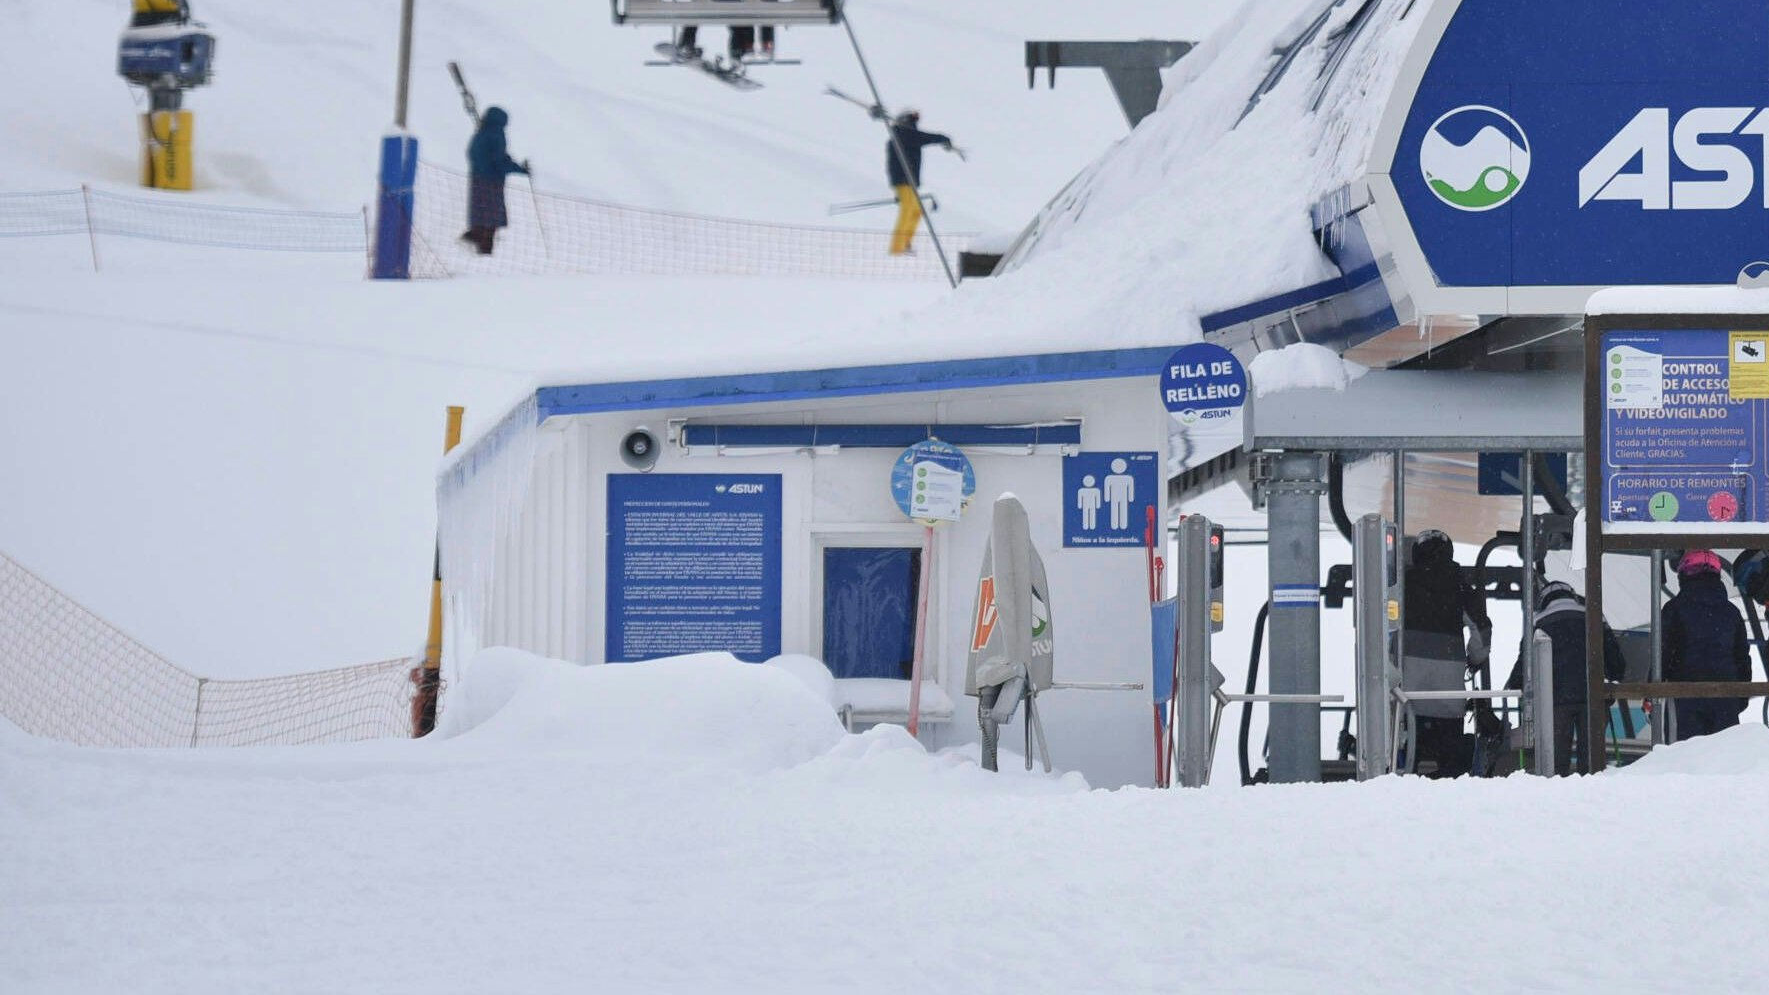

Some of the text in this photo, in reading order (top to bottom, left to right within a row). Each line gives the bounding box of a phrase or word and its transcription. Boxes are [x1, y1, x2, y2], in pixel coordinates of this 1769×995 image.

[1170, 360, 1233, 380] FILA DE
[1662, 363, 1722, 375] CONTROL
[1663, 378, 1680, 390] DE
[1682, 378, 1729, 390] ACCESO
[1166, 383, 1241, 403] RELLENO
[1663, 392, 1746, 405] AUTOMÁTICO
[1200, 409, 1231, 419] ASTUN
[1615, 408, 1728, 419] Y VIDEOVIGILADO
[1635, 426, 1661, 436] forfait
[1662, 428, 1699, 438] presenta
[1700, 426, 1744, 438] problemas
[1615, 438, 1641, 447] acuda
[1648, 438, 1656, 447] la
[1657, 438, 1686, 447] Oficina
[1687, 438, 1698, 447] de
[1738, 437, 1746, 447] al
[728, 483, 764, 494] ASTUN
[1617, 478, 1746, 489] HORARIO DE REMONTES
